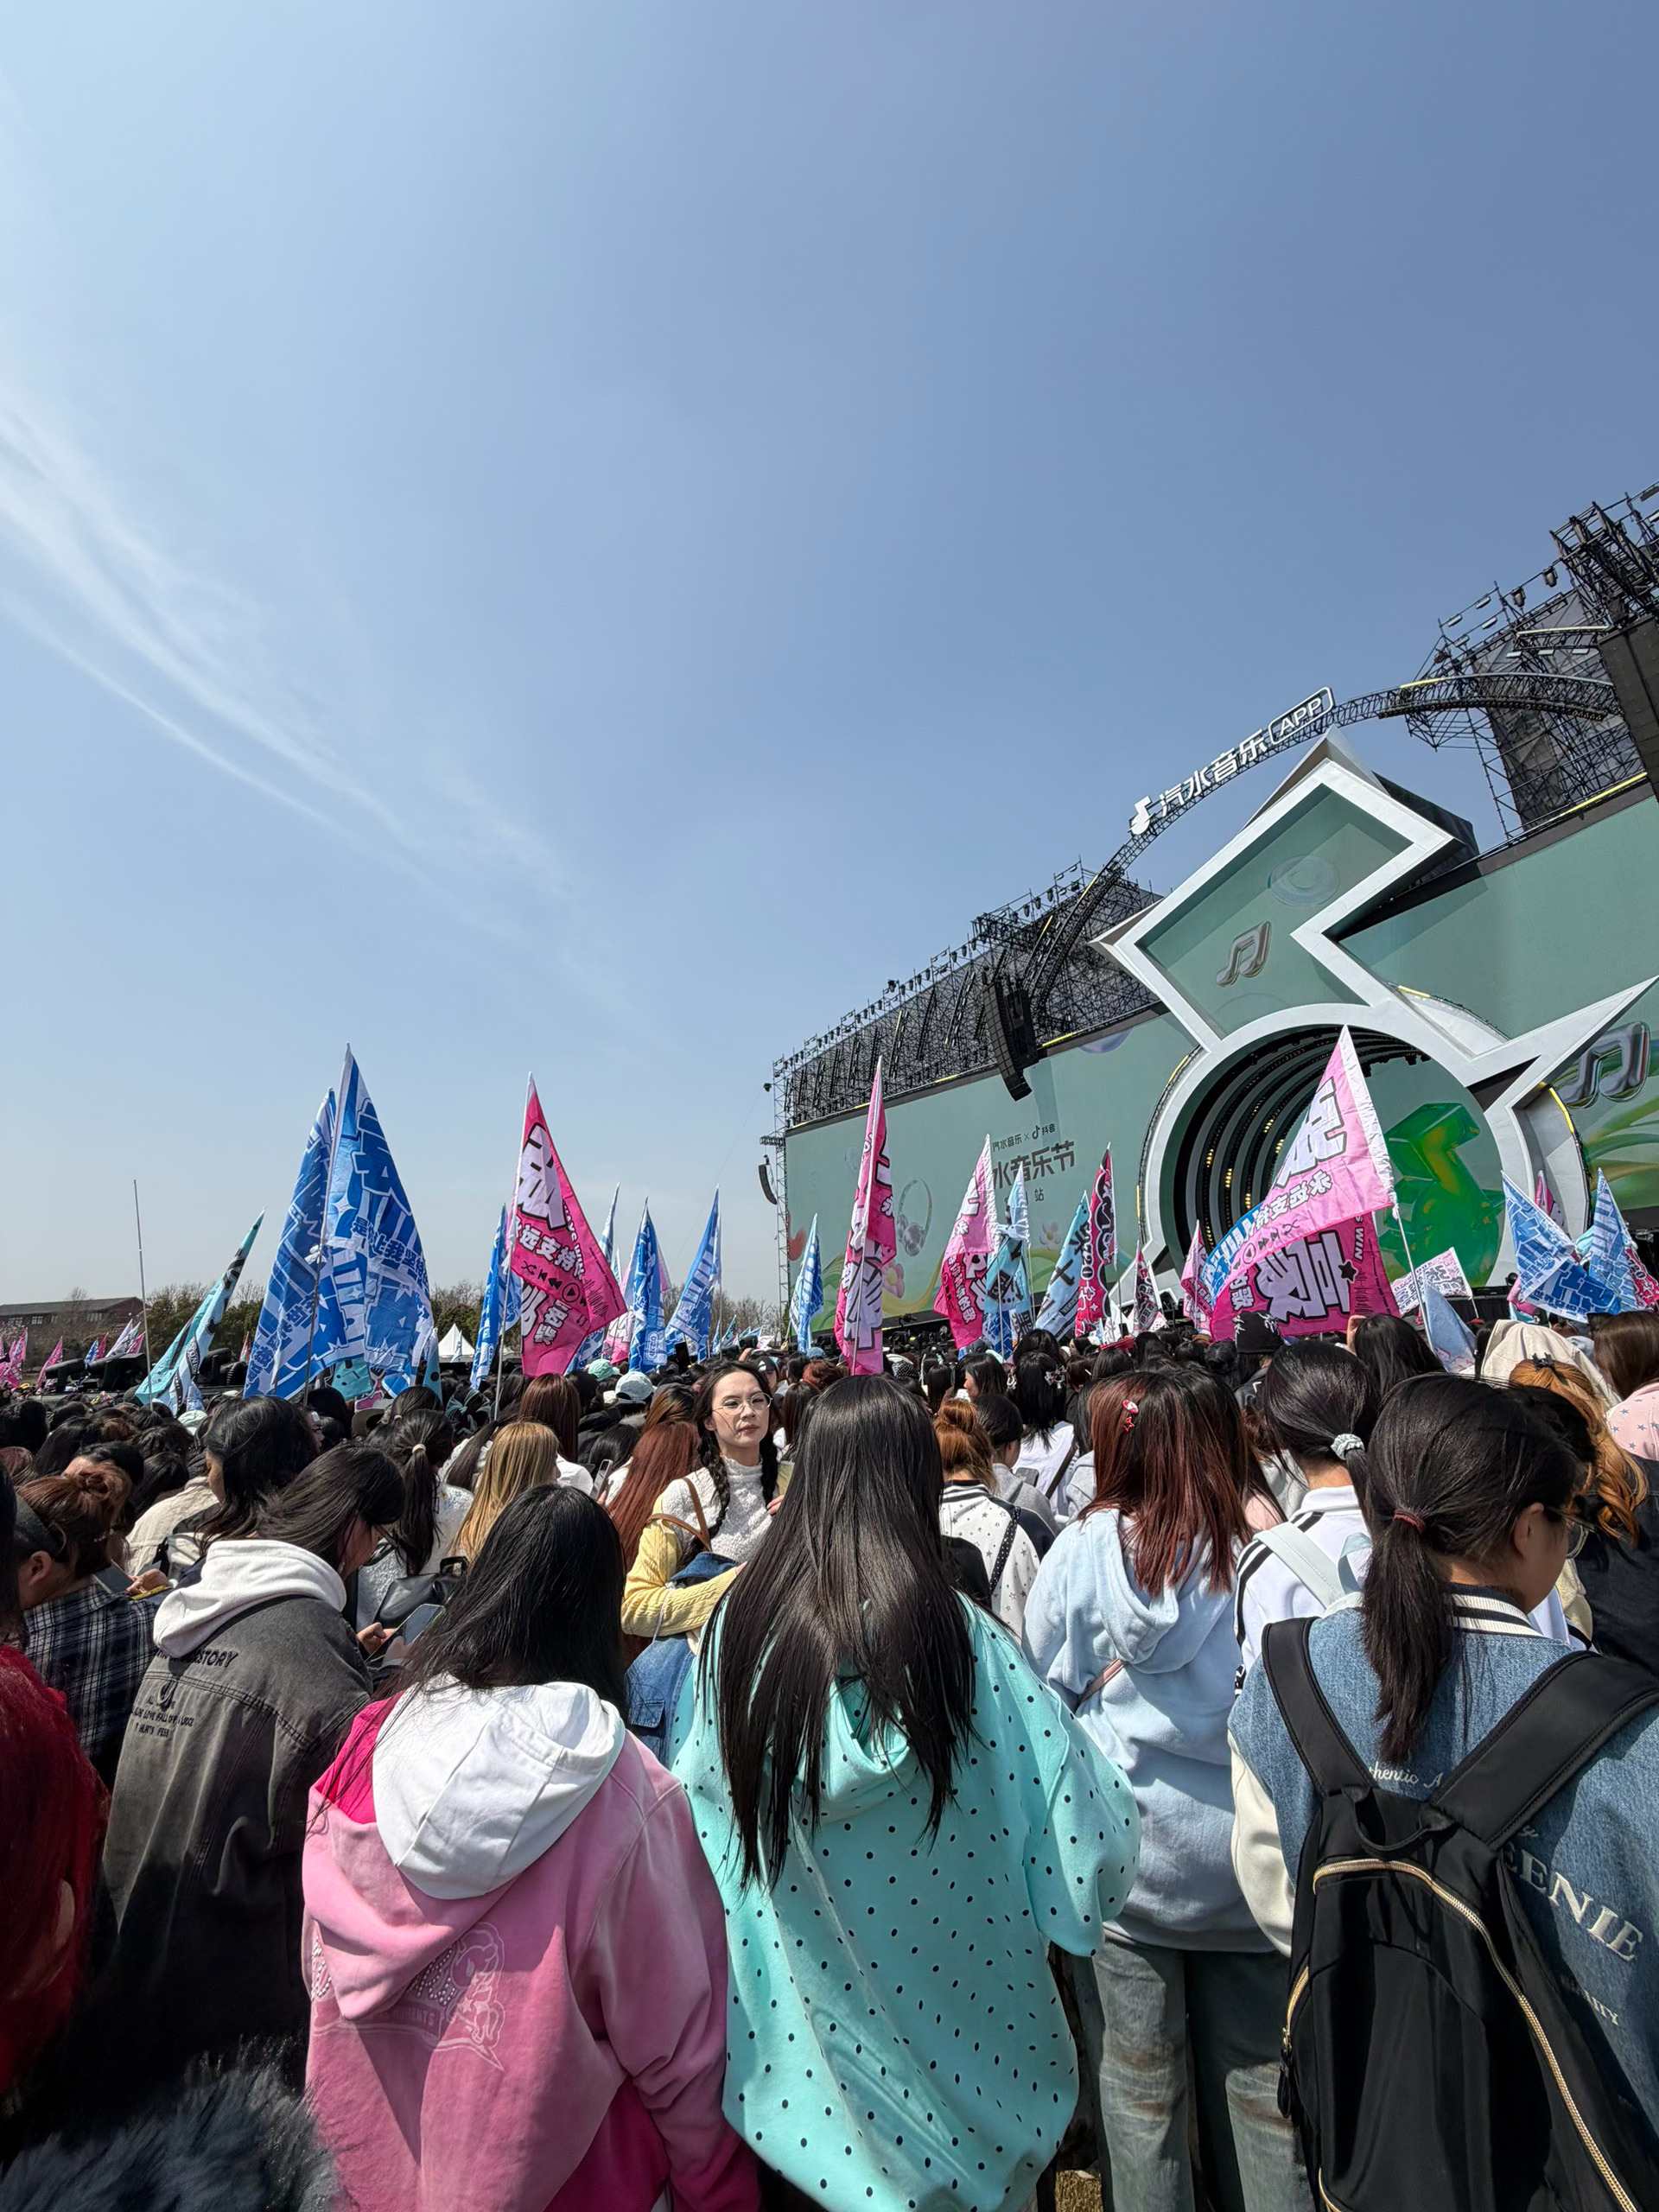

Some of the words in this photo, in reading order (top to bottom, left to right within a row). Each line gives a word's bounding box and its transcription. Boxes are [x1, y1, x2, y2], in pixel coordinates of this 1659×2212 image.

[1159, 728, 1268, 817] 汽水音乐
[1280, 696, 1322, 737] APP
[1041, 1123, 1056, 1136] 抖音
[992, 1140, 1075, 1191] 水音乐节
[1353, 1226, 1365, 1261] WIN
[1369, 1760, 1419, 1785] thentic
